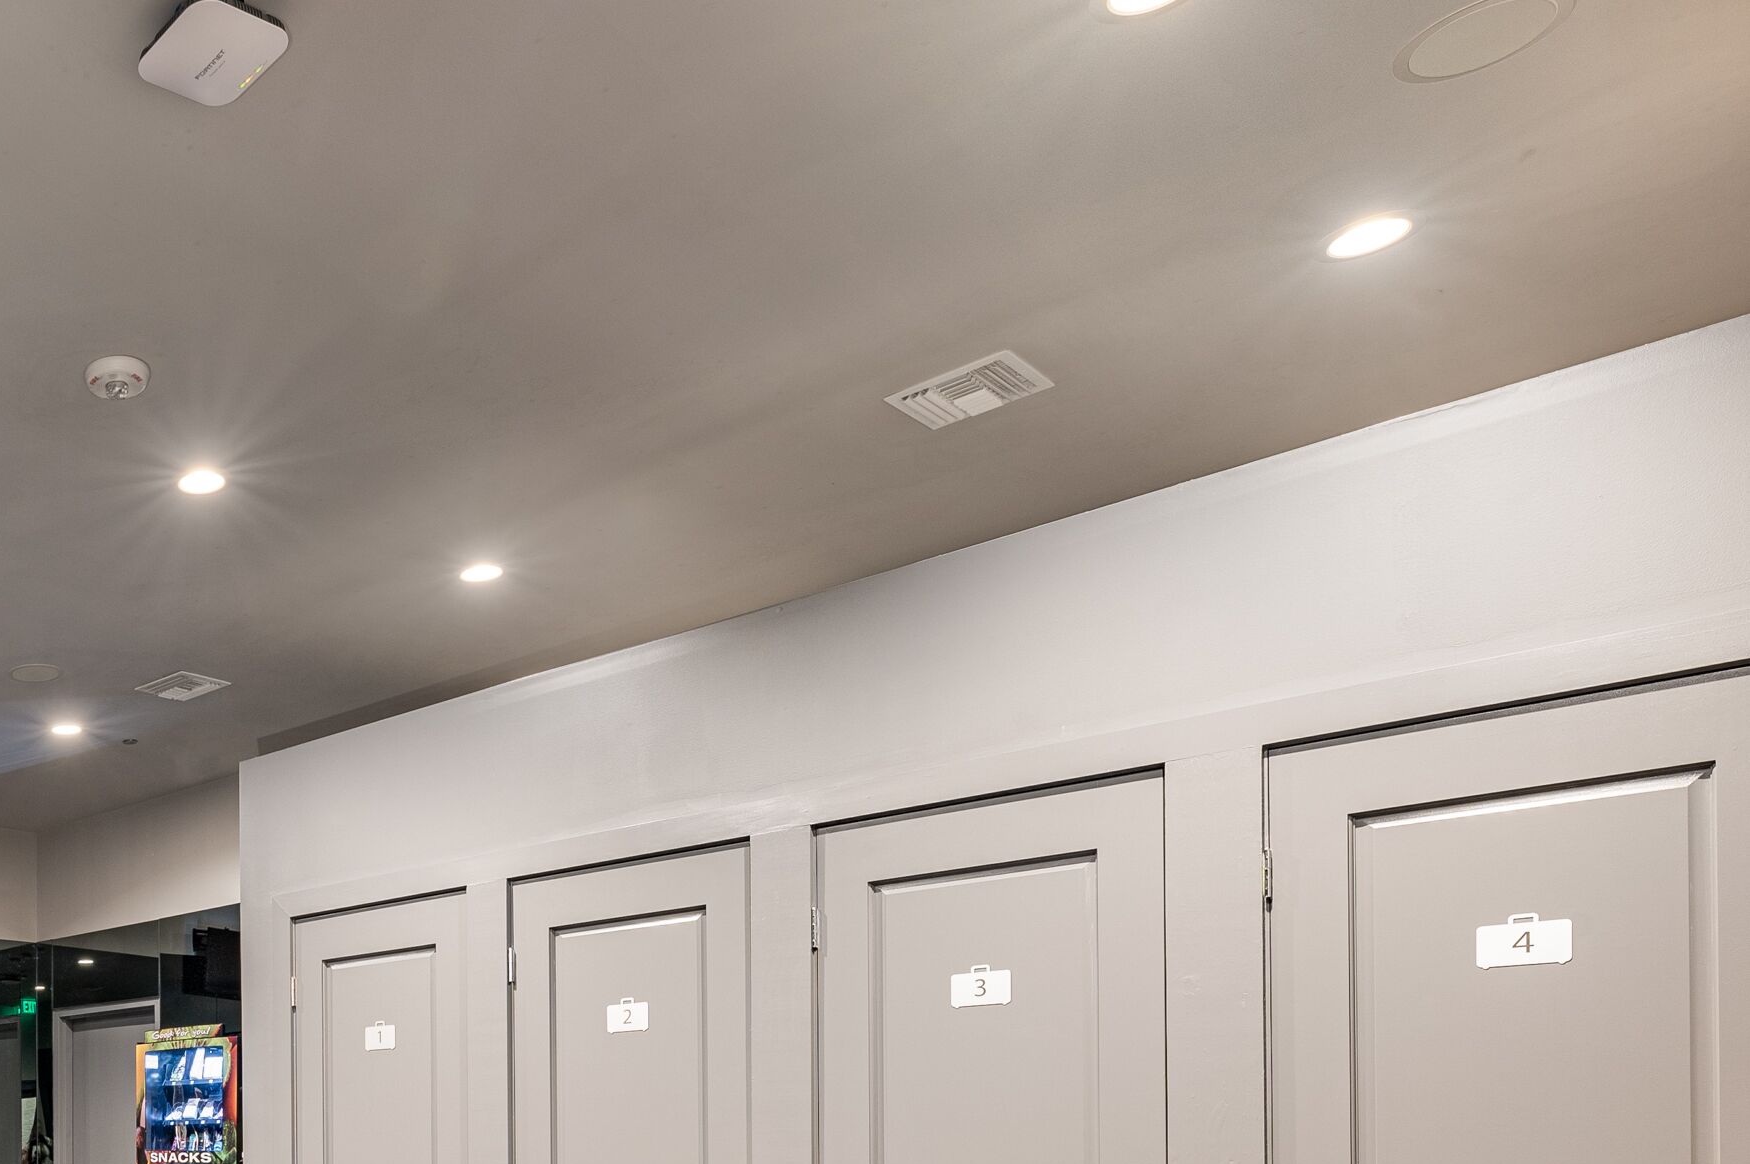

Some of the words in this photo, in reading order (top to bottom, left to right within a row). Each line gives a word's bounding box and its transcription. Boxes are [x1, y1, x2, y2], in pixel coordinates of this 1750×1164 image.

[1512, 931, 1535, 953] 4
[974, 978, 987, 997] 3
[623, 1009, 632, 1024] 2
[152, 1030, 175, 1040] Good
[176, 1028, 188, 1038] for
[192, 1026, 211, 1037] you!
[150, 1152, 212, 1164] SNACKS
